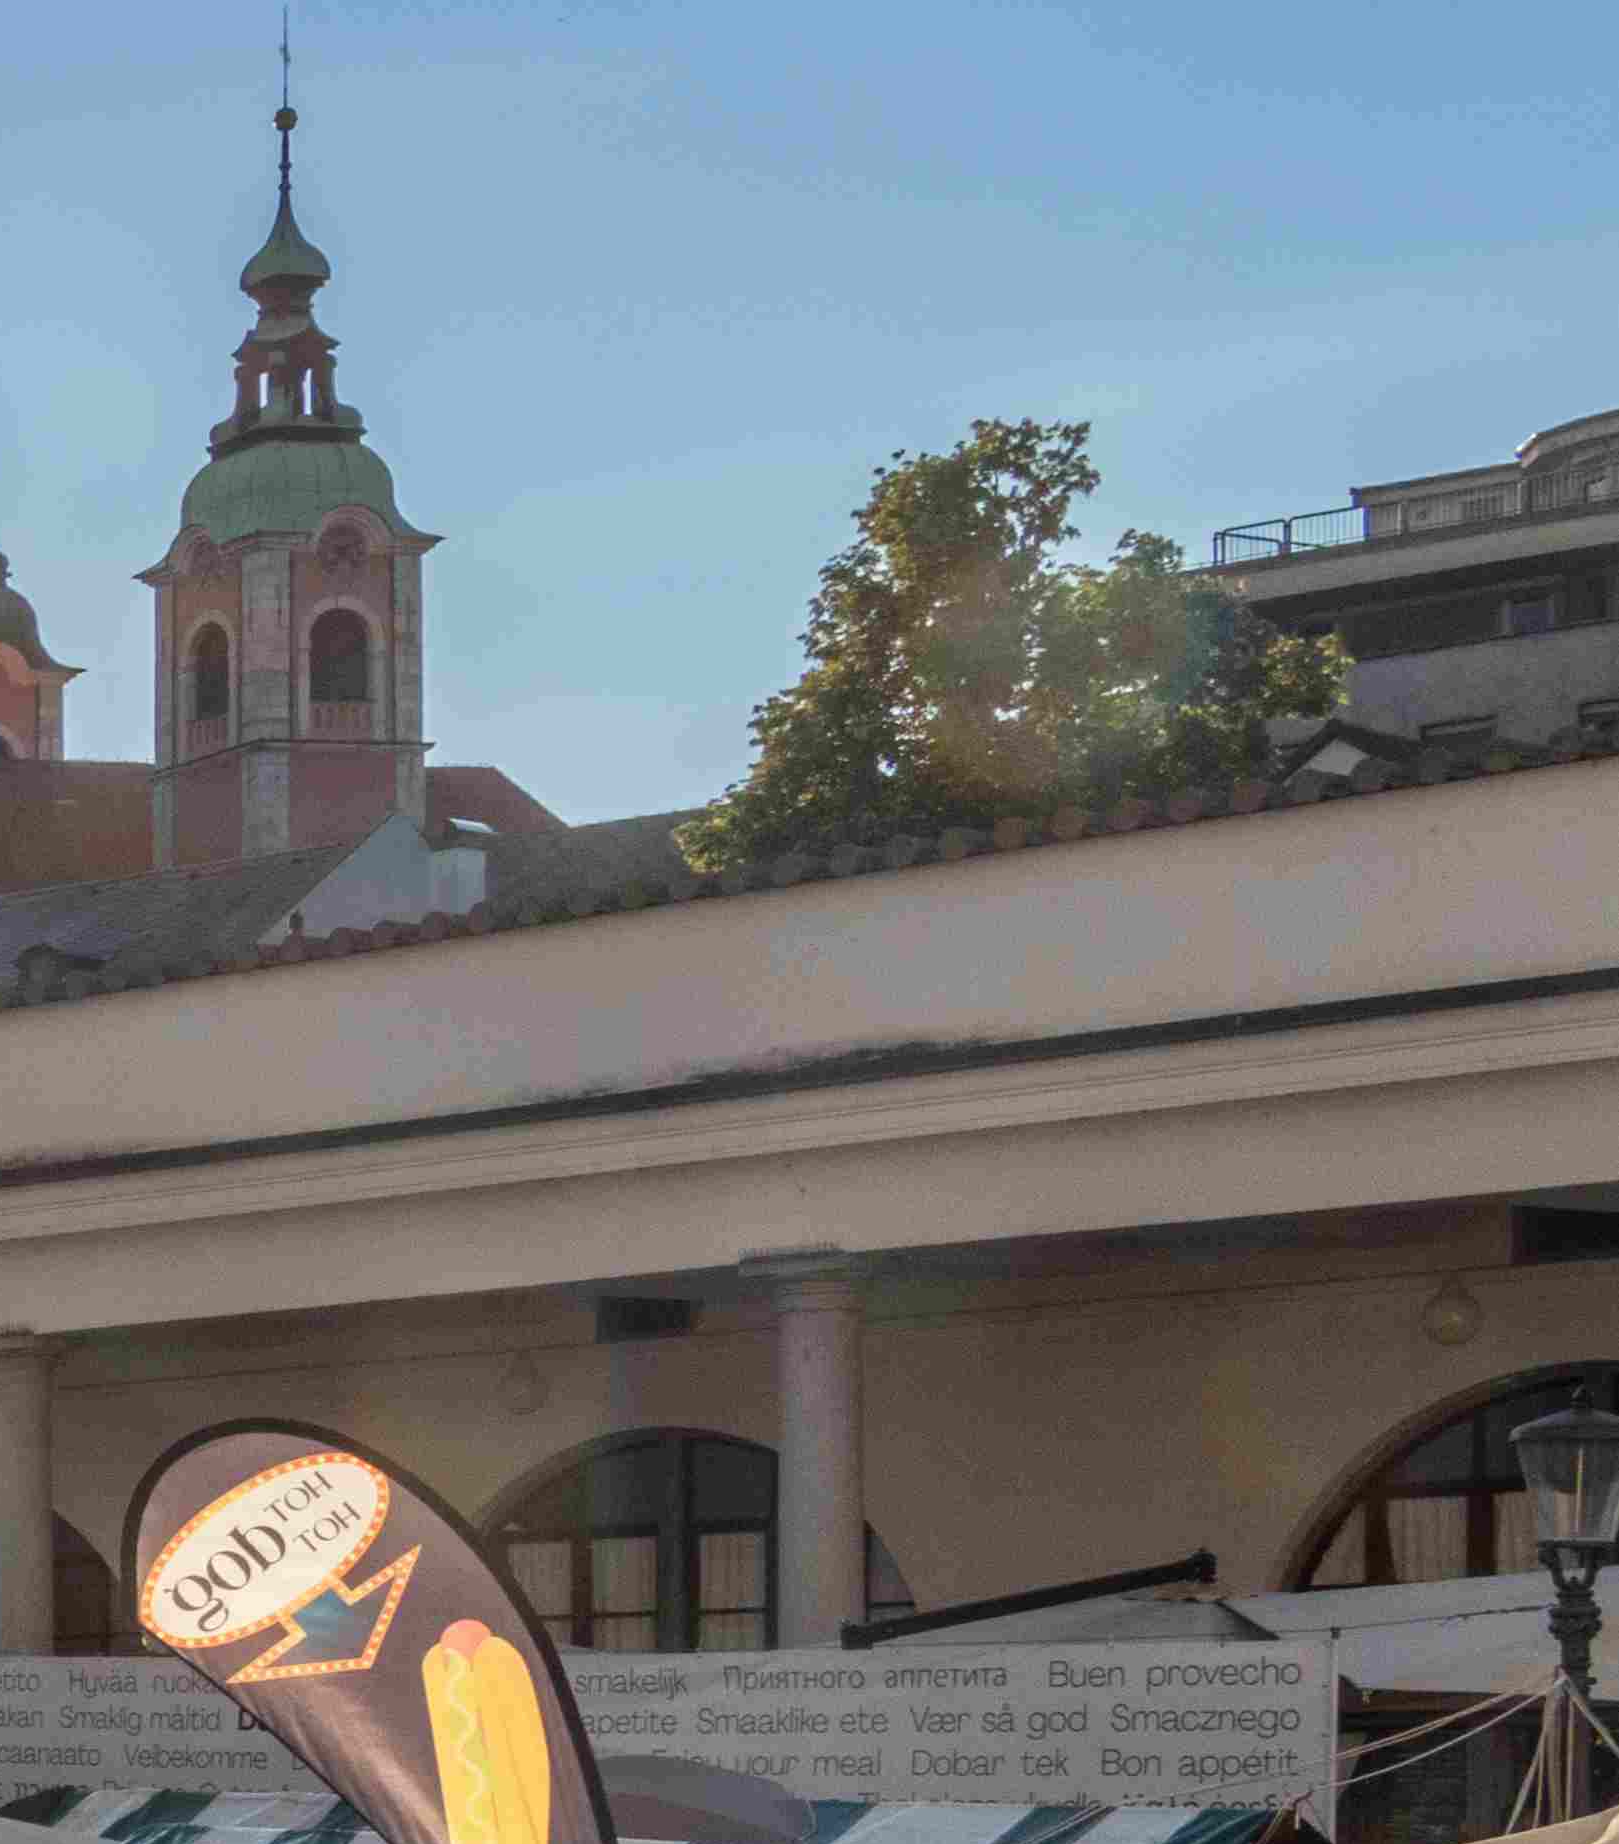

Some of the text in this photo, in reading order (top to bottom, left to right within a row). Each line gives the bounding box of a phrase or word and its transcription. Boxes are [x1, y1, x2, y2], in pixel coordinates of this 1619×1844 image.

[576, 1667, 688, 1700] smakelijk
[722, 1665, 1008, 1694] Приятного аппетита
[1048, 1656, 1301, 1692] Buen provecho
[697, 1706, 829, 1735] Smaaklike
[839, 1711, 890, 1735] ete
[908, 1704, 971, 1734] Vær
[981, 1702, 1014, 1733] så
[1027, 1703, 1088, 1740] god
[1110, 1703, 1301, 1739] Smacznego
[811, 1750, 882, 1777] meal
[911, 1749, 1003, 1777] Dobar
[1022, 1749, 1069, 1777] tek
[1101, 1749, 1162, 1777] Bon
